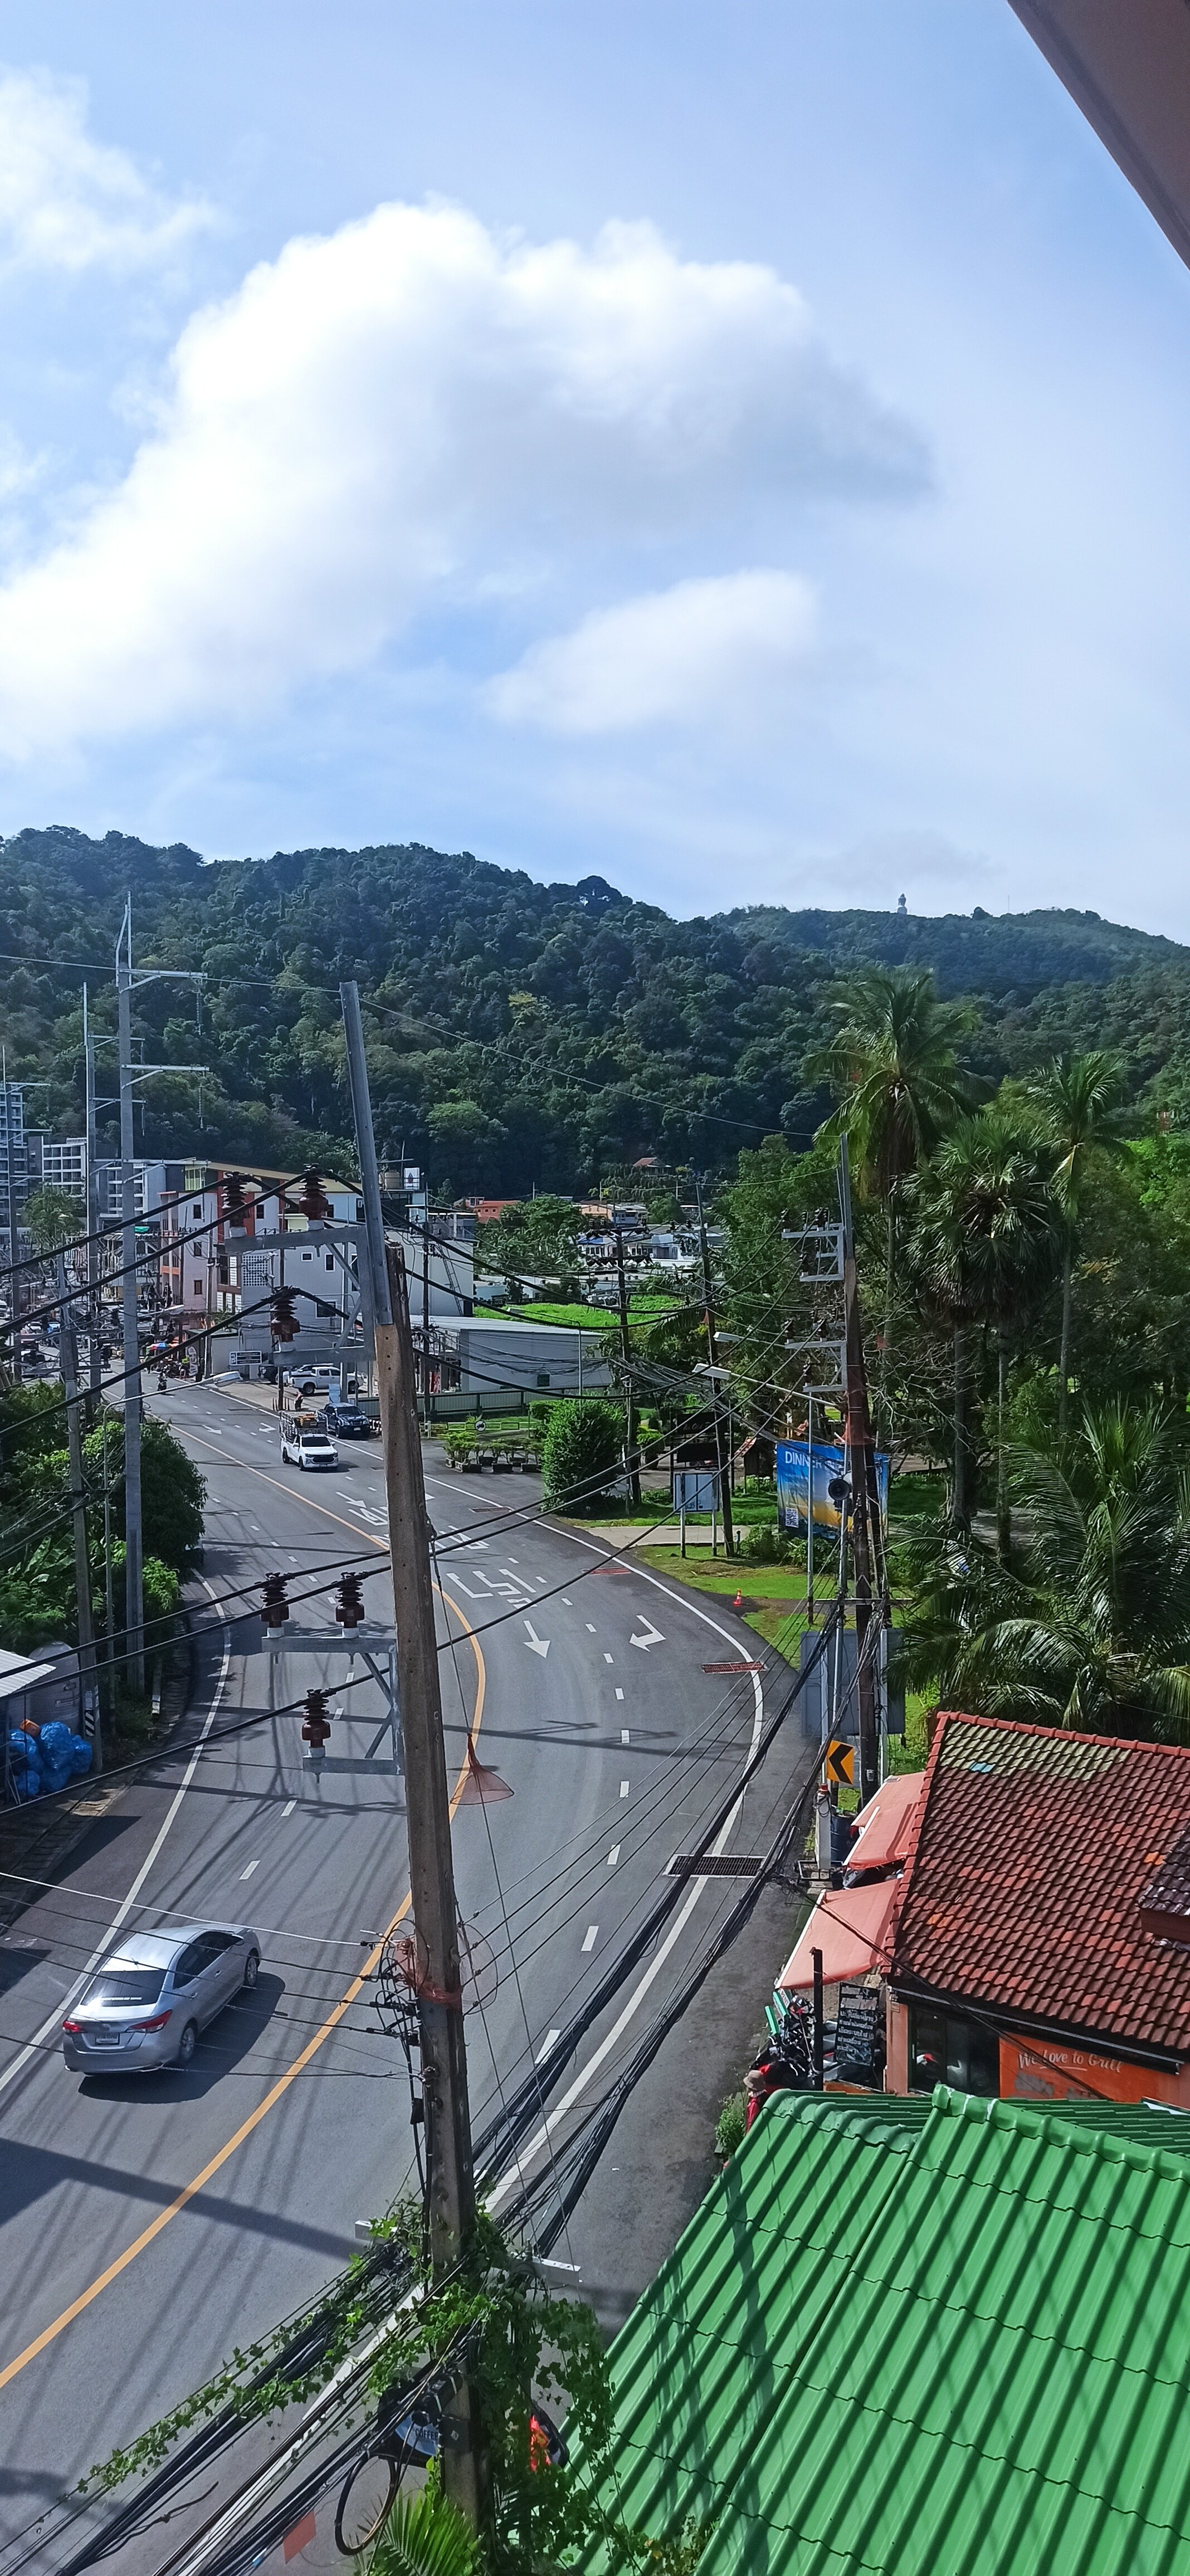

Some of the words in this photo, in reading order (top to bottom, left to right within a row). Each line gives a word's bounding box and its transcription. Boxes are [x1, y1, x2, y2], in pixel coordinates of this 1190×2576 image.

[1018, 2052, 1038, 2069] We
[1042, 2049, 1068, 2065] Love
[1072, 2052, 1084, 2065] to
[1088, 2053, 1121, 2073] Grill
